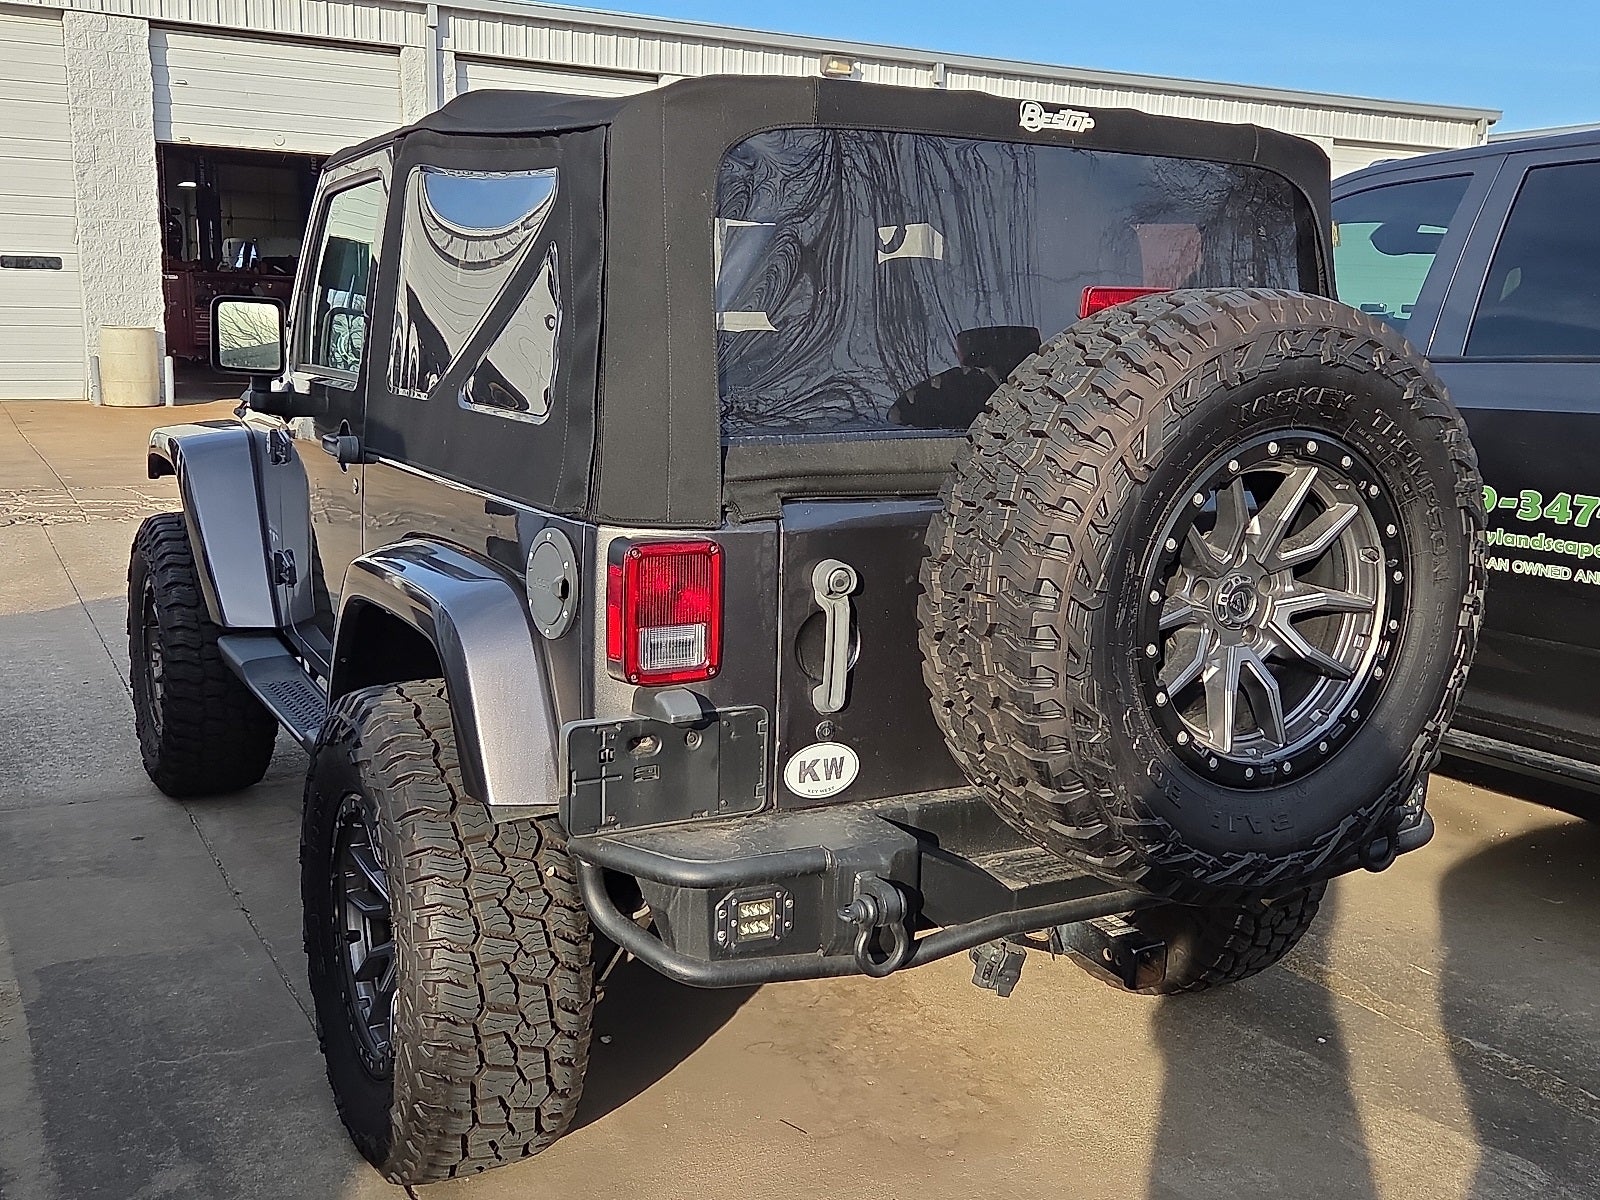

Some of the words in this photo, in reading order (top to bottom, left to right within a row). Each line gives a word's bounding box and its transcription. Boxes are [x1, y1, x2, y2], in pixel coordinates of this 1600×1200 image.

[1240, 386, 1357, 420] MICKEY
[1485, 557, 1509, 572] AN
[1512, 560, 1572, 580] OWNED
[1574, 569, 1600, 585] AN
[798, 756, 845, 784] KW
